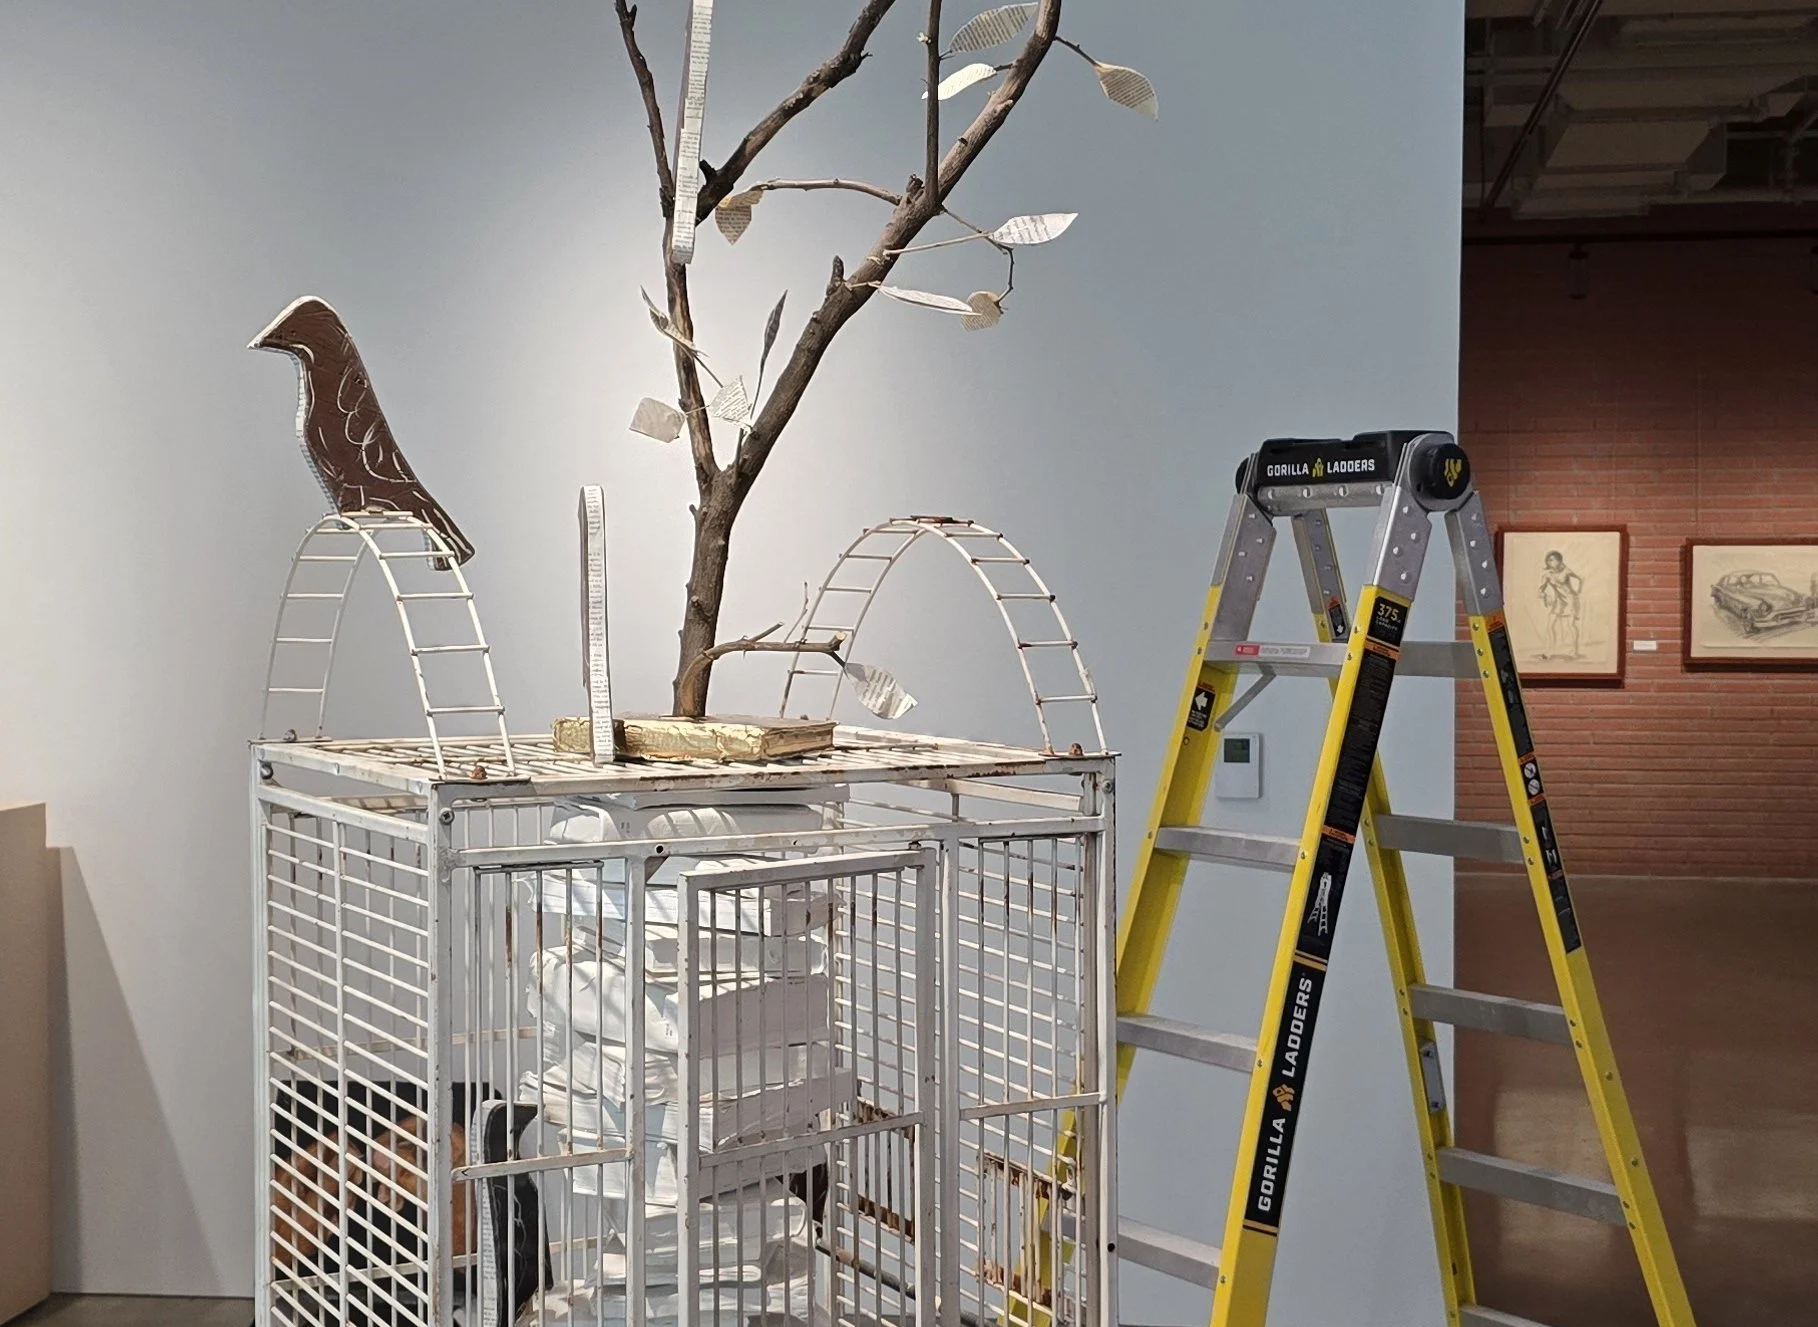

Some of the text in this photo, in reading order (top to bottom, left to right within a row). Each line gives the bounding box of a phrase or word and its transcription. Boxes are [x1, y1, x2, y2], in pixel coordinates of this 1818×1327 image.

[1266, 459, 1376, 477] GORILLA LADDERS
[1378, 604, 1399, 620] 375
[1257, 978, 1313, 1212] GORILLA LADDERS
